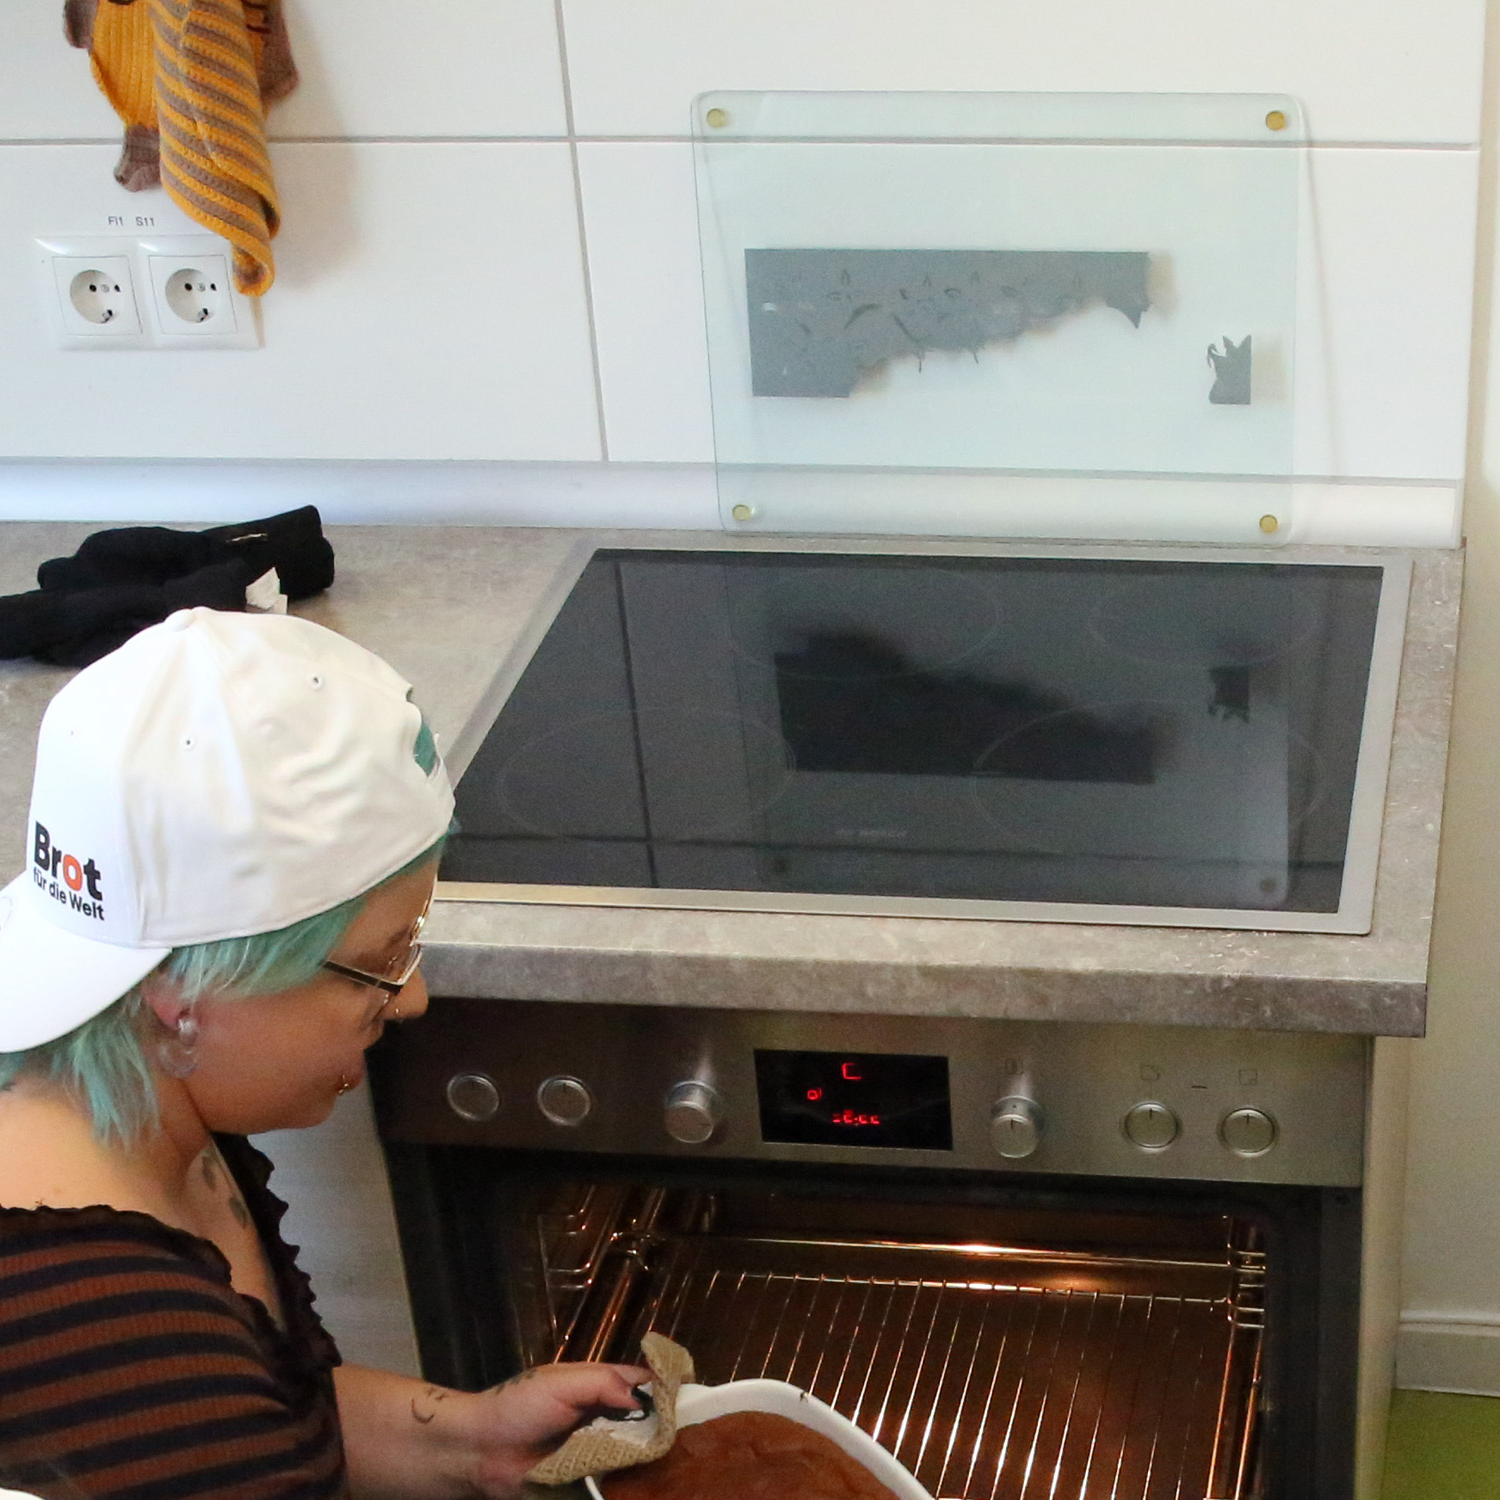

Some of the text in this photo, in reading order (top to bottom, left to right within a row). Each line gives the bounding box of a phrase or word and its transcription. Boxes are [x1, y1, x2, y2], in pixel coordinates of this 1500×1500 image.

[33, 866, 105, 921] für die Welt
[34, 820, 103, 901] Brot
